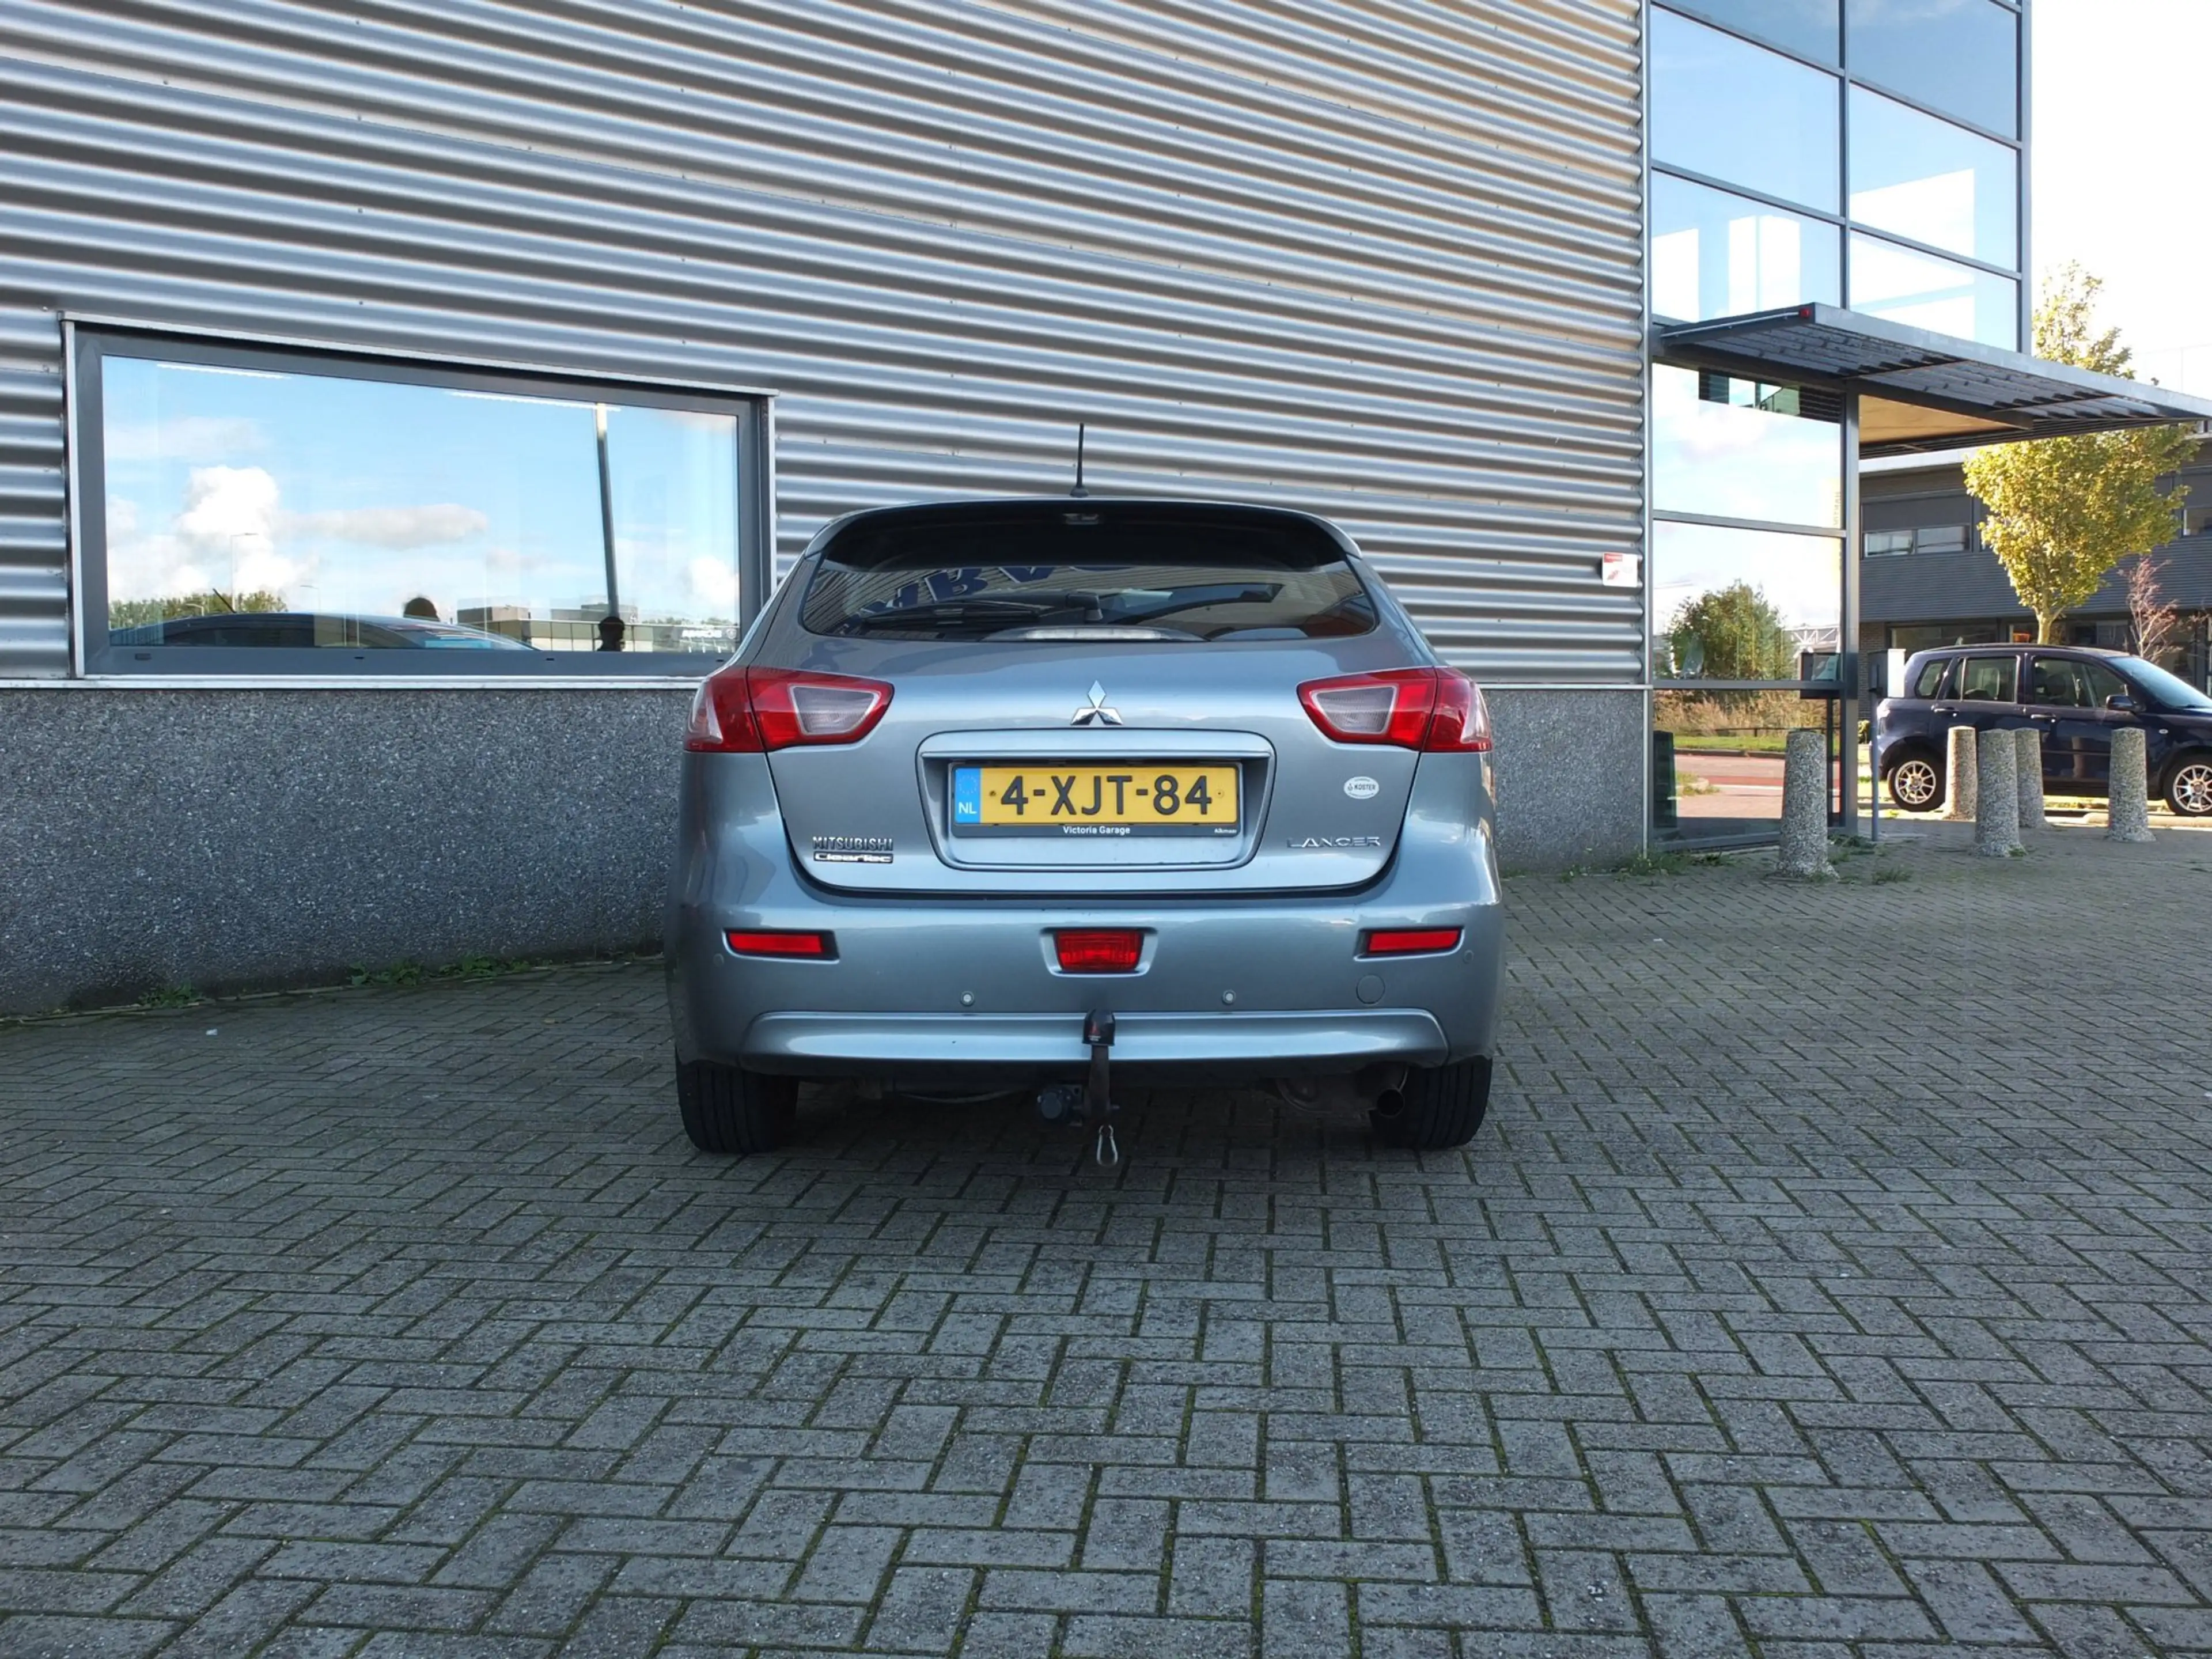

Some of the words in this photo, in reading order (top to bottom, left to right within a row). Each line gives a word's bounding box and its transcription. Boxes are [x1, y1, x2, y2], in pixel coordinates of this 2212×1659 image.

[1000, 775, 1213, 816] 4-XJT-84
[958, 801, 978, 815] NL
[1063, 825, 1097, 834] Victoria
[1099, 825, 1130, 836] Garage
[812, 836, 893, 851] MITSUBISHI
[1287, 836, 1381, 848] LANCER
